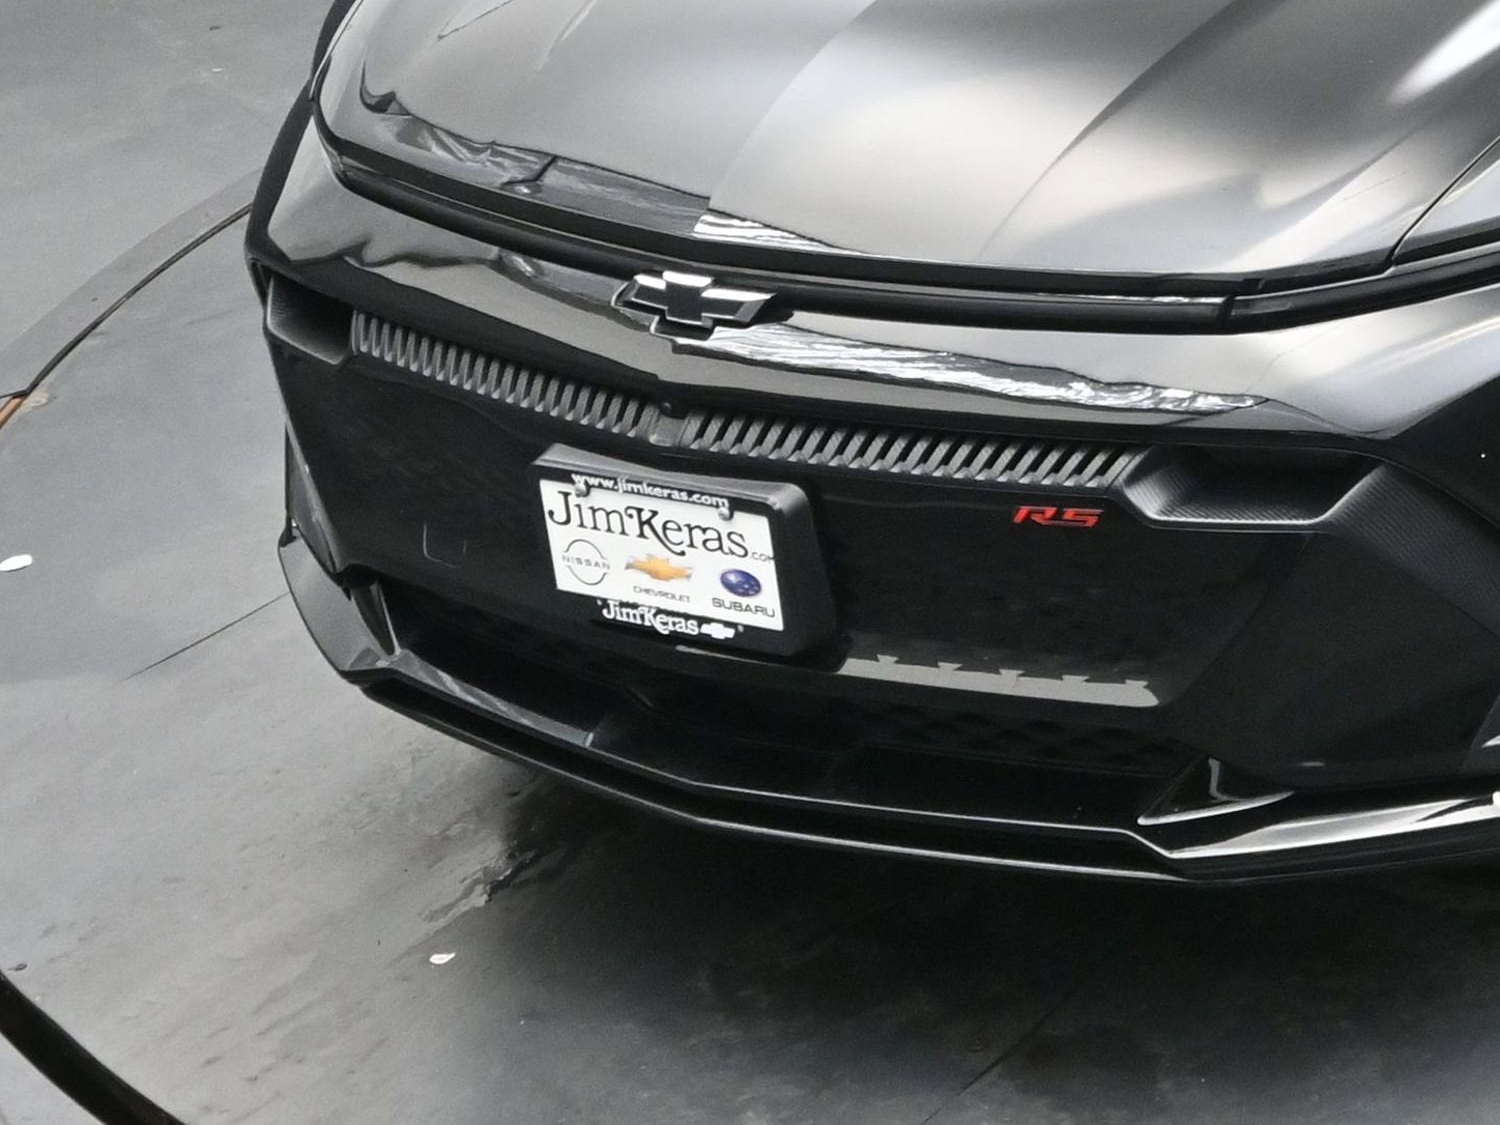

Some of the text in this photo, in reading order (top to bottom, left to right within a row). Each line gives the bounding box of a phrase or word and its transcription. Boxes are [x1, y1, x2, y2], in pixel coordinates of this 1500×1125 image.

[571, 473, 729, 508] www.jimkeras.com
[1013, 506, 1104, 527] RS
[561, 554, 611, 570] NISSAN
[633, 585, 691, 603] CHEVROLET
[601, 599, 699, 636] JimKeras
[711, 597, 776, 618] SUBARU
